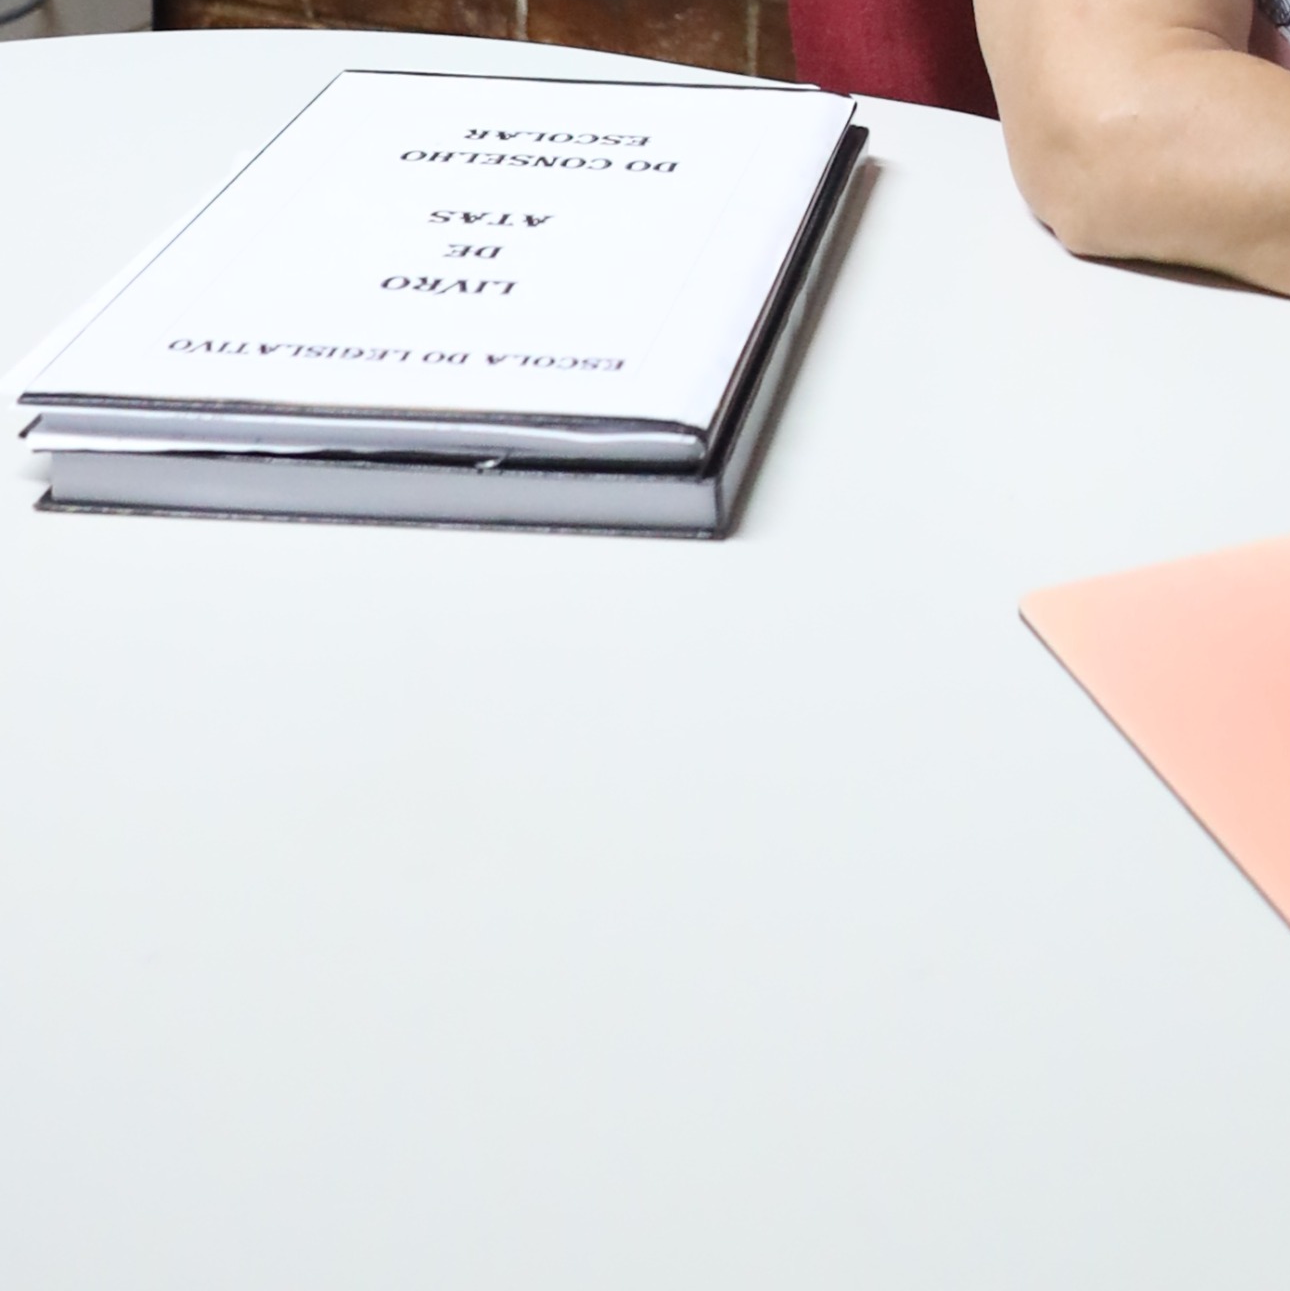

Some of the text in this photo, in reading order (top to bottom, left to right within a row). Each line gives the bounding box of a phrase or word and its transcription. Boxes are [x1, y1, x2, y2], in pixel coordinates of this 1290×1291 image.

[464, 128, 651, 147] ESCOLAR
[400, 150, 680, 173] DO CONSELHO
[428, 210, 554, 227] ATAS
[443, 244, 503, 259] DE
[380, 274, 519, 295] LIVRO
[168, 338, 627, 372] ESCOLA DO LEGISLATIVO
